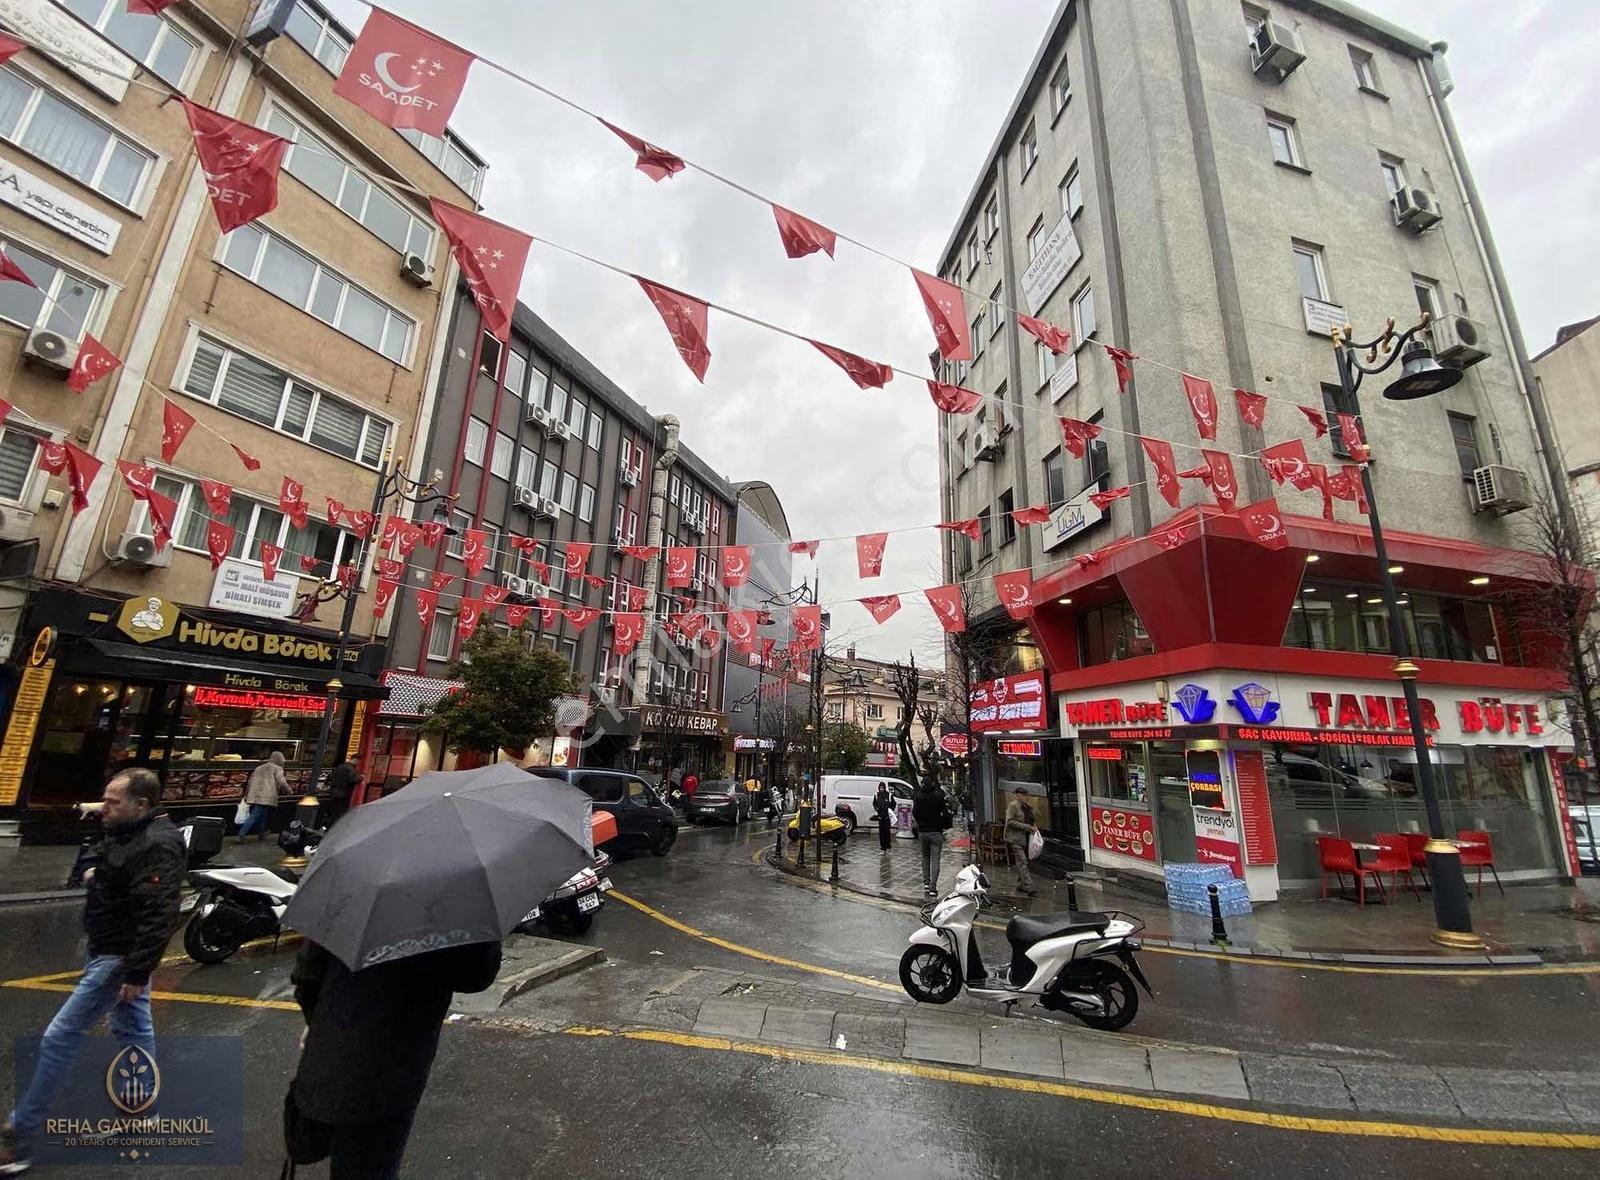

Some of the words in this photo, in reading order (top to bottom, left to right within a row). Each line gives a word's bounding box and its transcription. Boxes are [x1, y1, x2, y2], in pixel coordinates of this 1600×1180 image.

[358, 73, 438, 112] SAADET
[56, 205, 110, 240] denetim
[179, 620, 258, 652] Hivda
[263, 634, 332, 663] Börek
[225, 673, 262, 687] Hivda
[275, 679, 309, 692] Börek
[1066, 698, 1124, 724] TANER
[1125, 702, 1168, 722] BÜFE
[1309, 692, 1440, 731] TANER
[1458, 697, 1543, 735] BÜFE
[687, 716, 718, 730] KEBAP
[1262, 729, 1312, 743] KAVURMA
[1319, 731, 1356, 744] SOSİSLİ
[1190, 782, 1222, 793] ÇORBASI
[1196, 814, 1235, 828] trendyol
[1103, 826, 1124, 837] TANER
[1124, 828, 1142, 841] BÜFE
